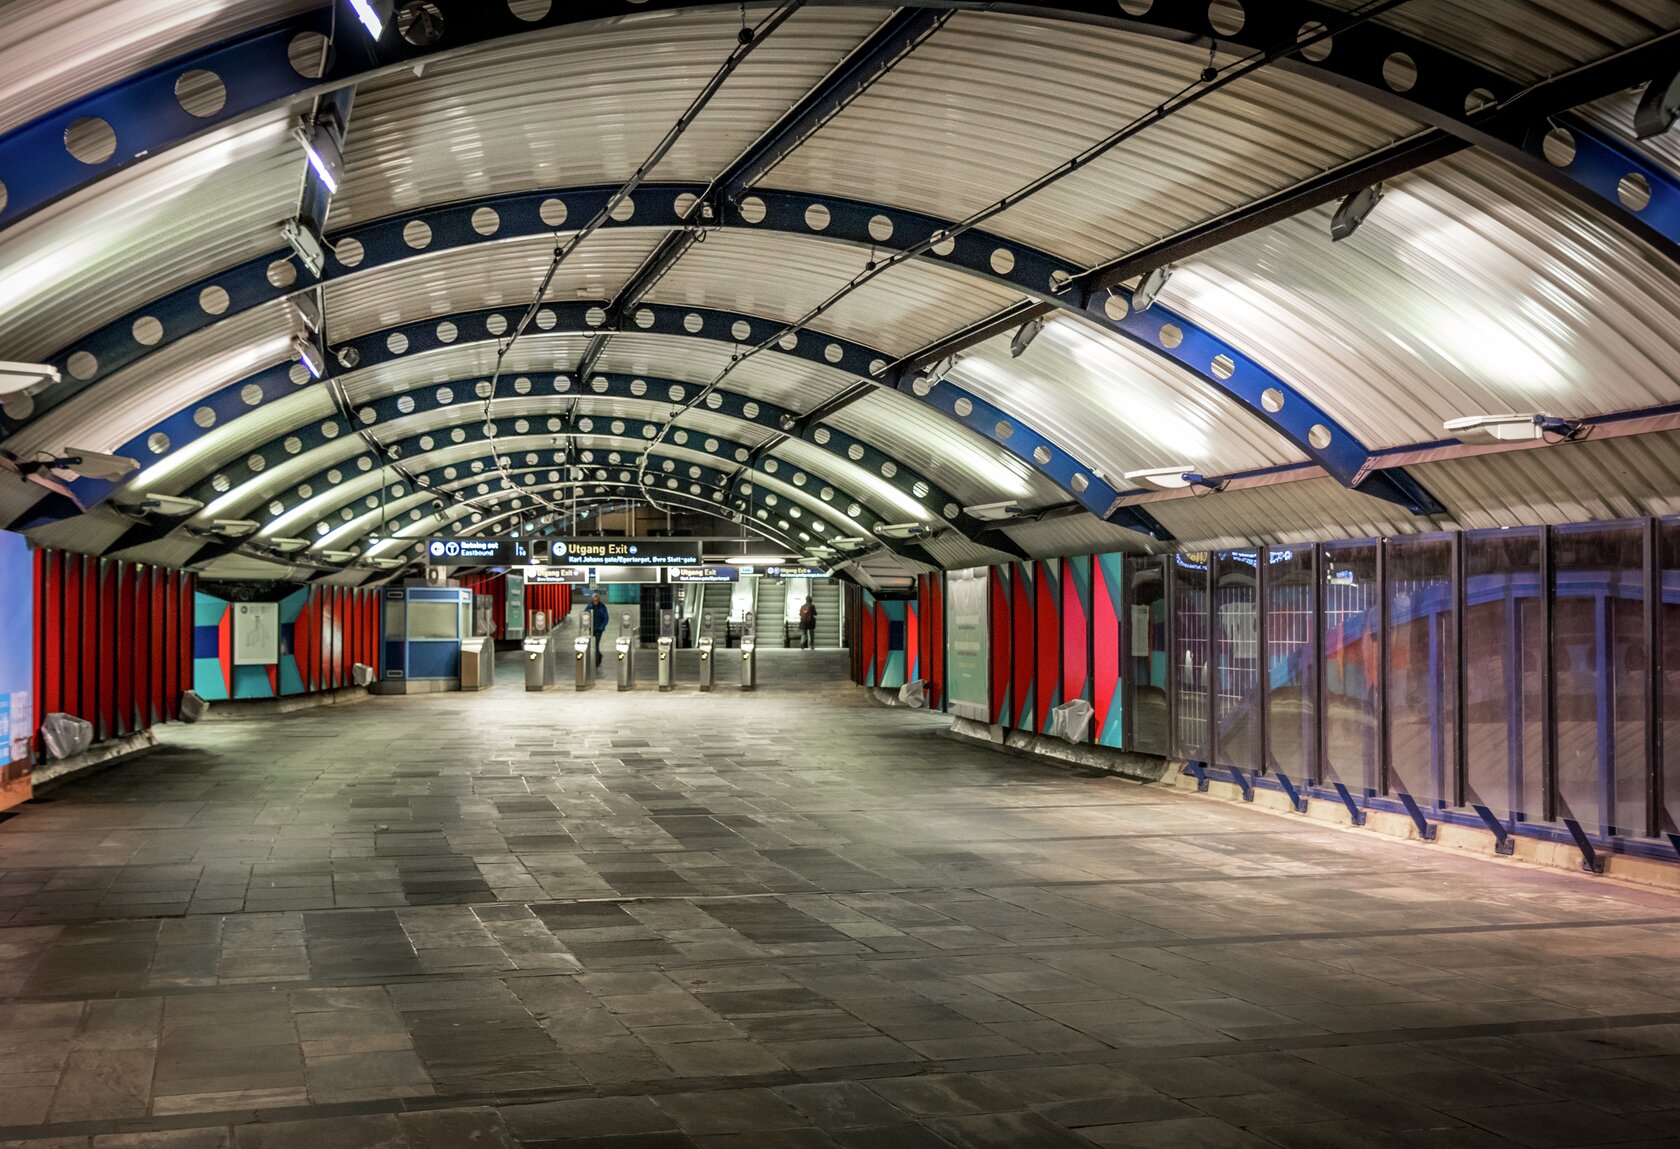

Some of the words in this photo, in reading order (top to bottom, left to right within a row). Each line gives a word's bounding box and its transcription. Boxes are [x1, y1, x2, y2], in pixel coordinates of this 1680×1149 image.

[568, 543, 606, 556] Utgang
[608, 543, 628, 554] Exit
[537, 569, 560, 577] Utgang
[680, 568, 703, 577] Utgang
[704, 568, 717, 576] Exit
